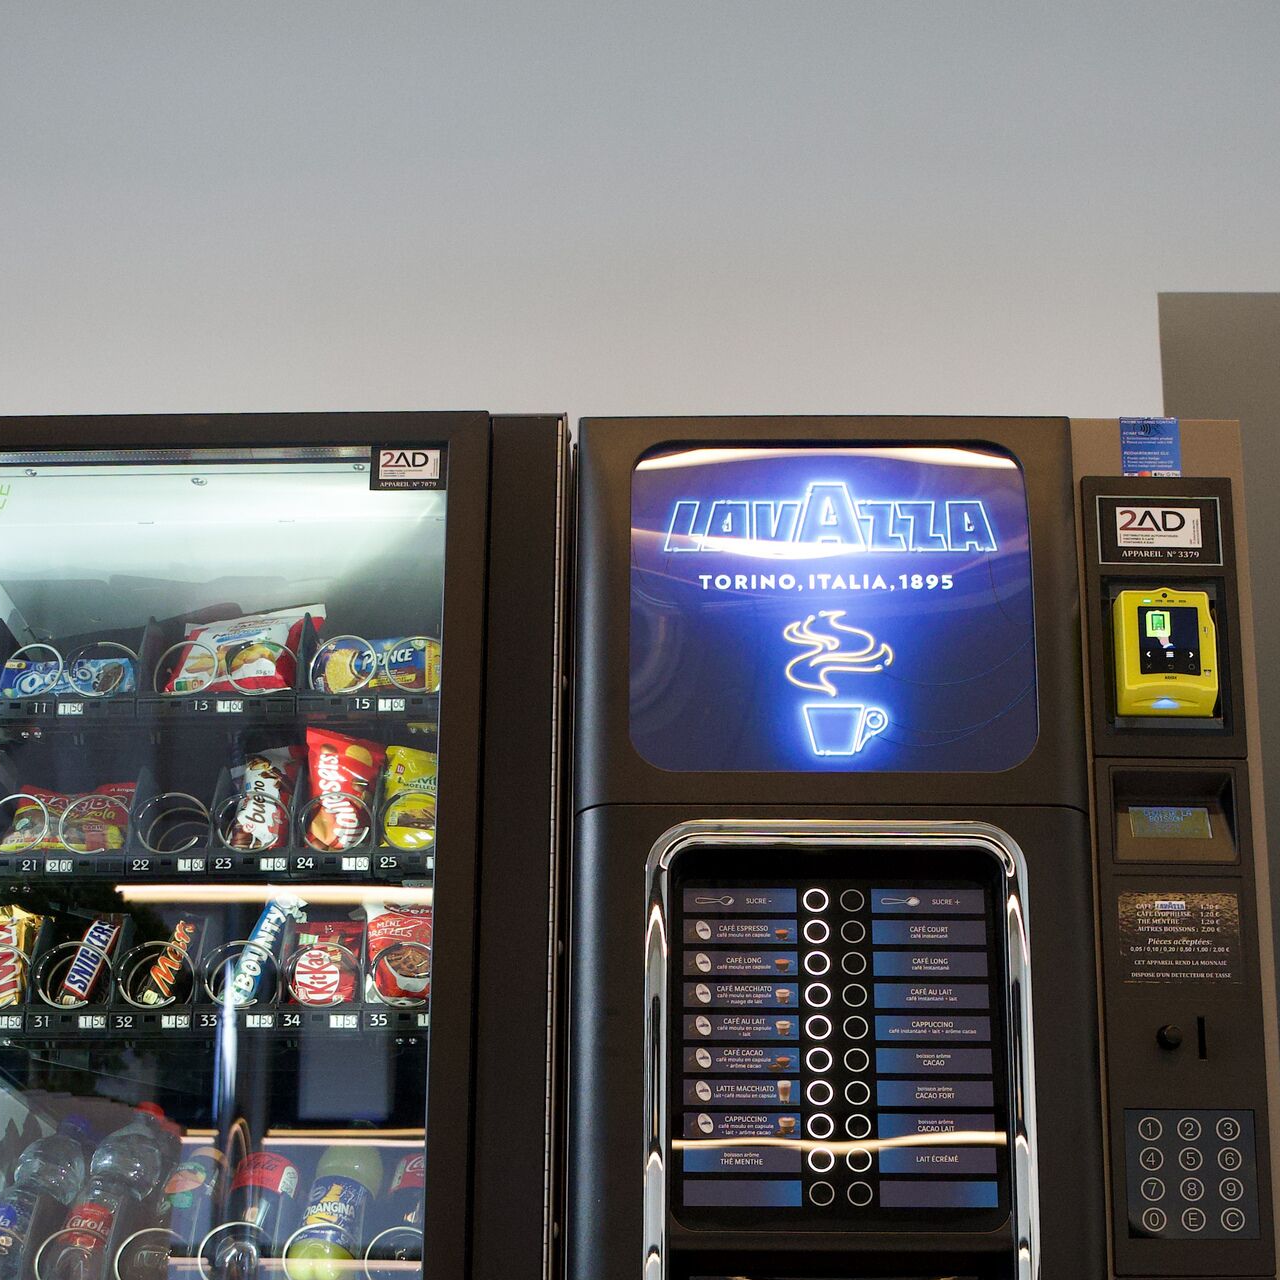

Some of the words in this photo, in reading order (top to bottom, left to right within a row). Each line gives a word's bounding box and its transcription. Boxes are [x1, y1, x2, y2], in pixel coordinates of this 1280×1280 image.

[381, 451, 429, 467] 2AD
[663, 481, 999, 553] LAVAZZA
[1119, 510, 1186, 532] 2AD
[1121, 550, 1163, 558] APPAREIL
[1178, 551, 1200, 559] 3379
[698, 573, 804, 592] TORINO,
[808, 573, 895, 592] ITALIA,
[899, 573, 954, 590] 1895
[33, 702, 47, 714] 11
[193, 700, 209, 711] 13
[355, 698, 370, 710] 15
[21, 859, 37, 871] 21
[132, 859, 150, 871] 22
[215, 858, 232, 869] 23
[297, 857, 314, 869] 24
[380, 857, 397, 868] 25
[745, 897, 768, 905] SUCRE
[376, 920, 401, 929] MINI
[233, 905, 287, 994] BOUNTY
[150, 920, 197, 998] Mars
[295, 949, 341, 999] KitKat
[34, 1016, 49, 1028] 31
[115, 1016, 133, 1028] 32
[200, 1014, 217, 1027] 33
[283, 1014, 301, 1027] 34
[370, 1014, 387, 1026] 35
[723, 1017, 740, 1025] CAFÉ
[741, 1017, 751, 1025] AU
[751, 1017, 766, 1025] LAIT
[1146, 1122, 1153, 1136] 1
[1184, 1122, 1195, 1136] 2
[1223, 1122, 1233, 1136] 3
[916, 1154, 931, 1163] LAIT
[931, 1154, 959, 1163] ÉCRÉMÉ
[1145, 1152, 1156, 1166] 4
[1186, 1152, 1196, 1166] 5
[1224, 1152, 1235, 1166] 6
[1148, 1182, 1157, 1196] 7
[1187, 1182, 1198, 1196] 8
[1226, 1182, 1236, 1196] 9
[303, 1201, 355, 1219] ORANGINA
[1149, 1212, 1159, 1227] 0
[1188, 1212, 1198, 1227] E
[1226, 1212, 1239, 1227] C
